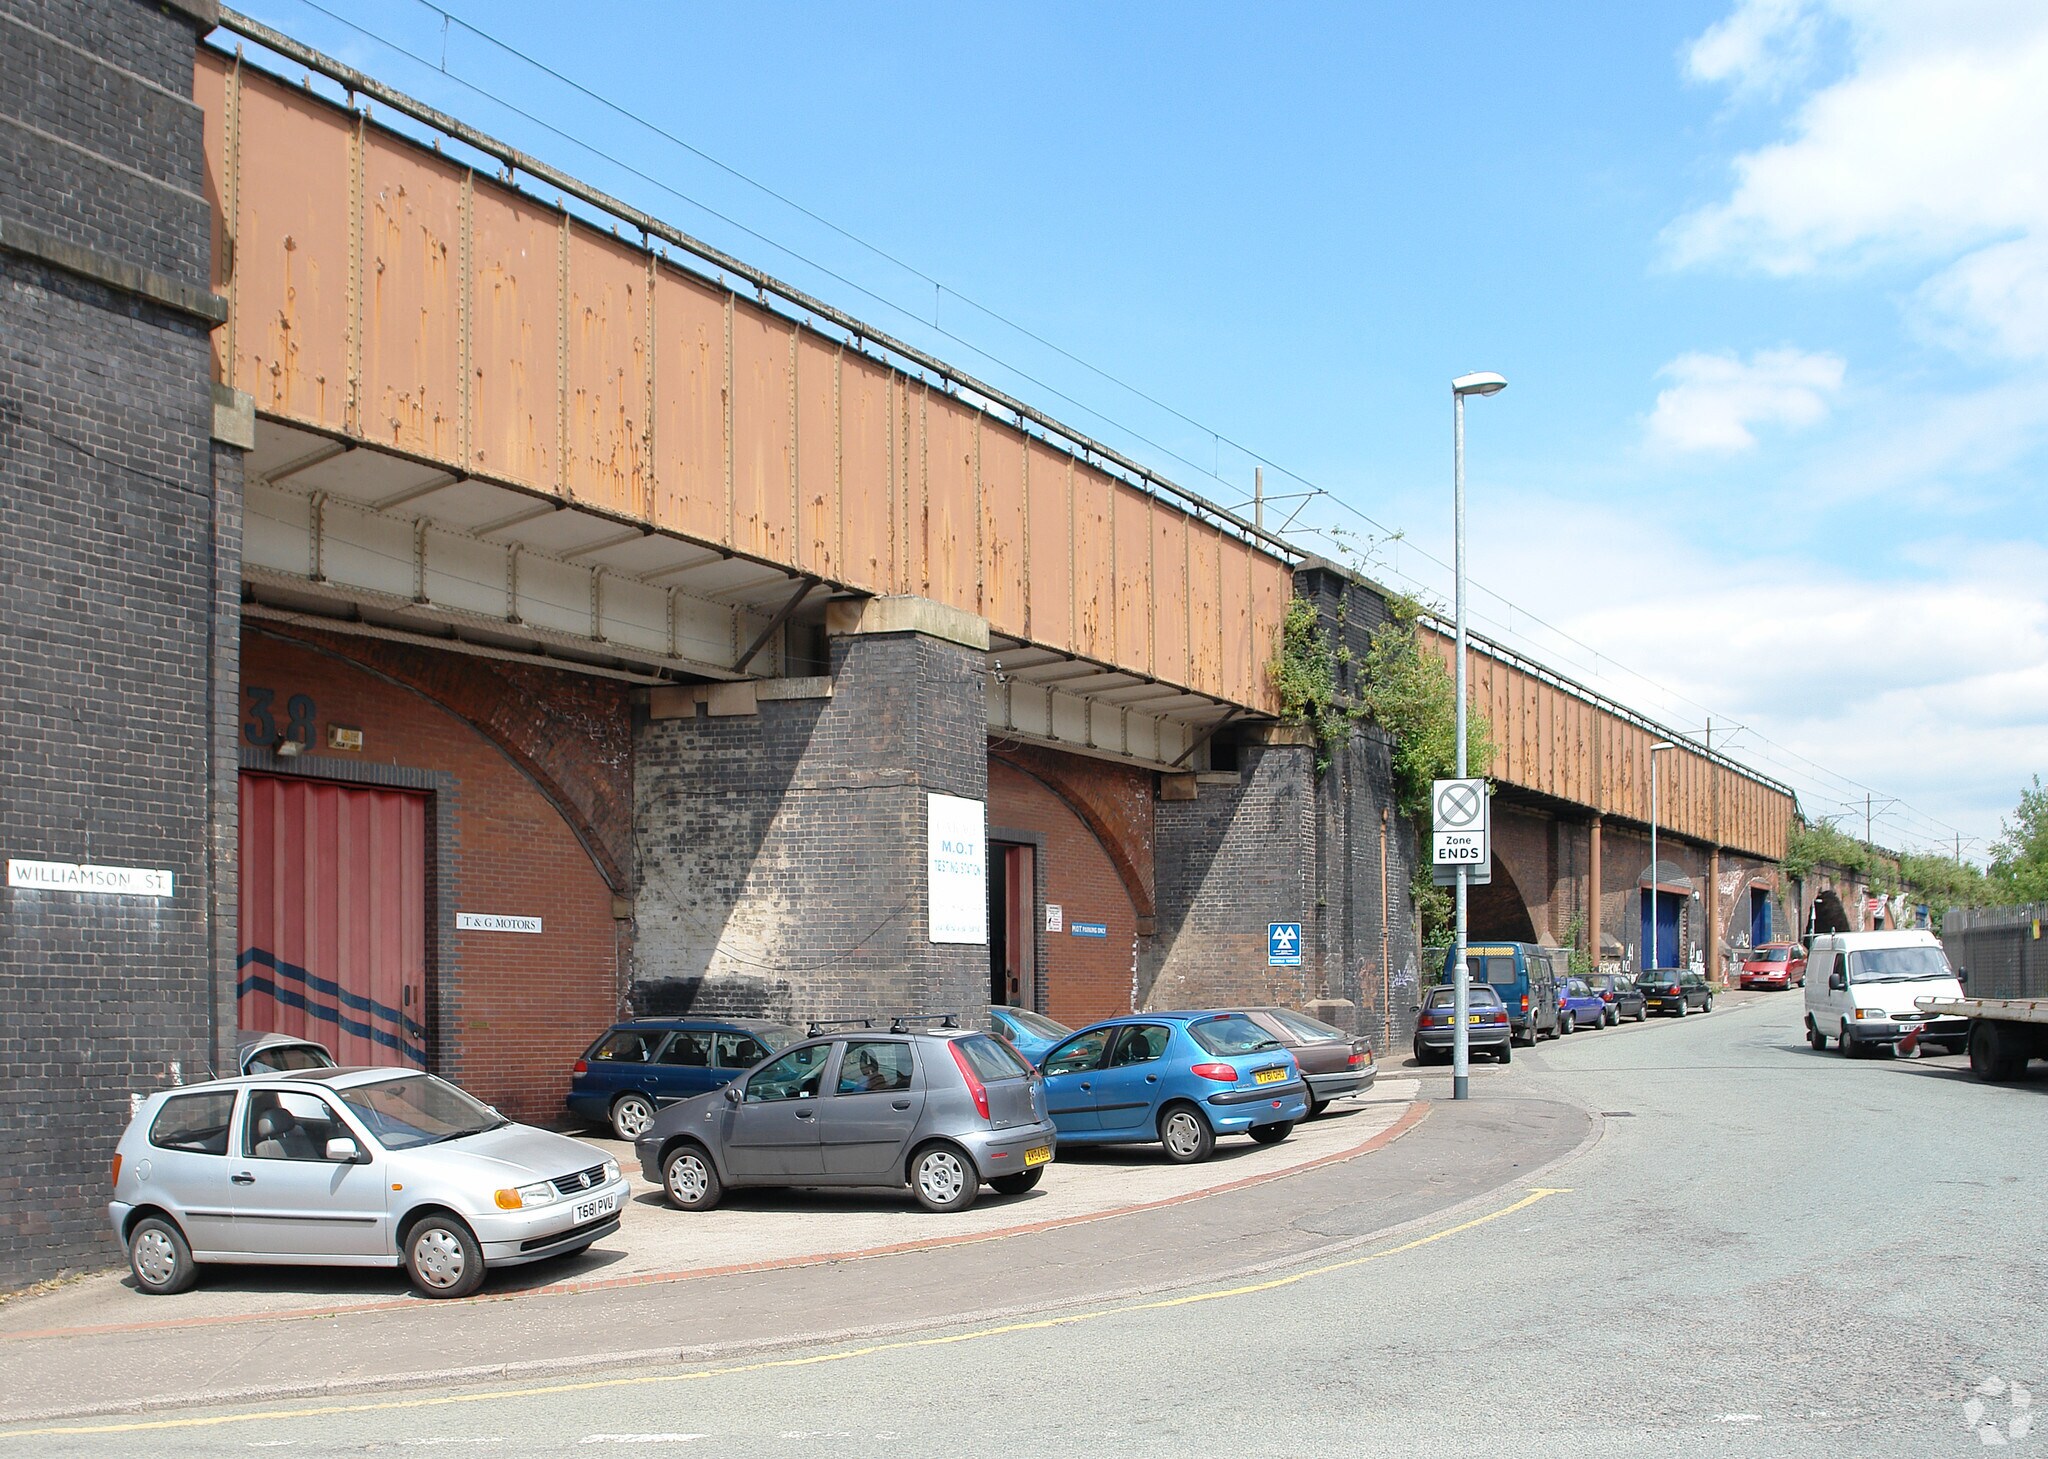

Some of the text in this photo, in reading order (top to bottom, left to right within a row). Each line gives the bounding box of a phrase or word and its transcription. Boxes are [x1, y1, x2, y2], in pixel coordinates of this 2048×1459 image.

[244, 686, 317, 751] 38
[1446, 836, 1472, 845] Zone
[1439, 848, 1479, 859] ENDS
[15, 865, 131, 887] WILLIAMSON
[464, 916, 536, 930] T & G MOTORS
[577, 1195, 613, 1219] T681 PVU
